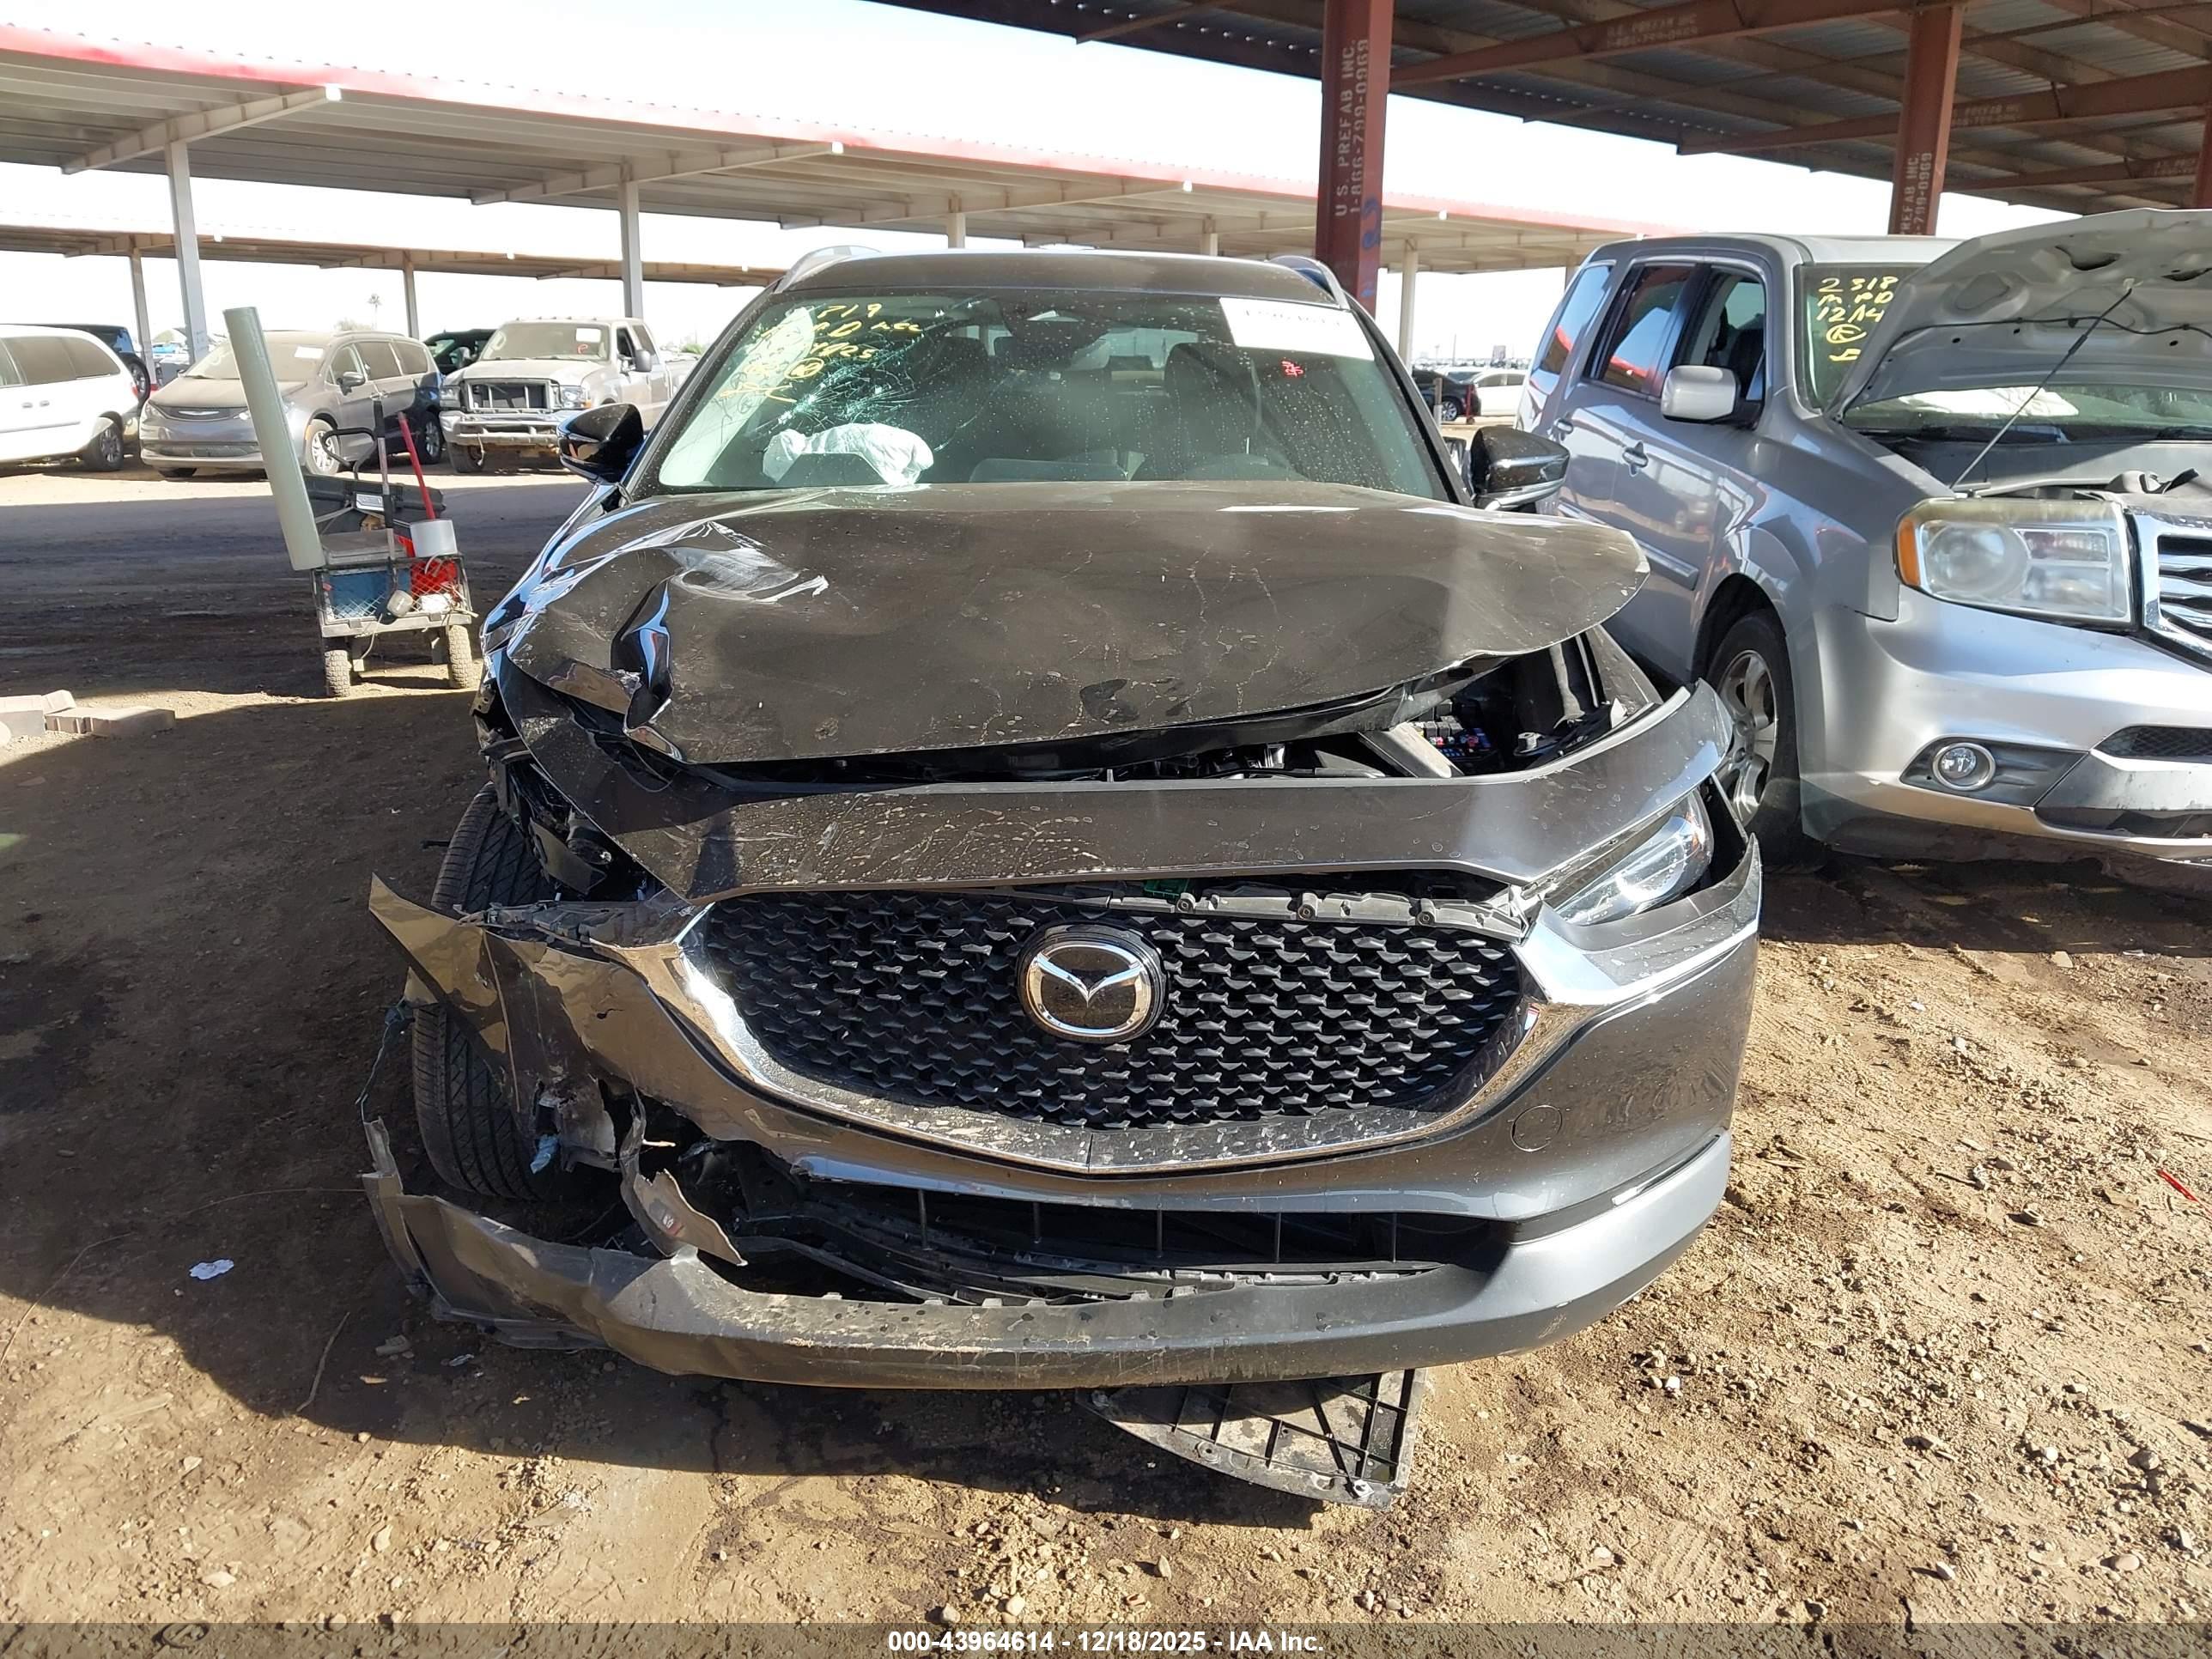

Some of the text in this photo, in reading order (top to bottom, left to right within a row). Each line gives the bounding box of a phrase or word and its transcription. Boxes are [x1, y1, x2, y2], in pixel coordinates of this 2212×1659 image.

[1341, 40, 1356, 80] INC.
[1338, 88, 1354, 167] PREFAB
[1349, 39, 1369, 214] 1-866-799-0969
[1818, 277, 1844, 293] 2
